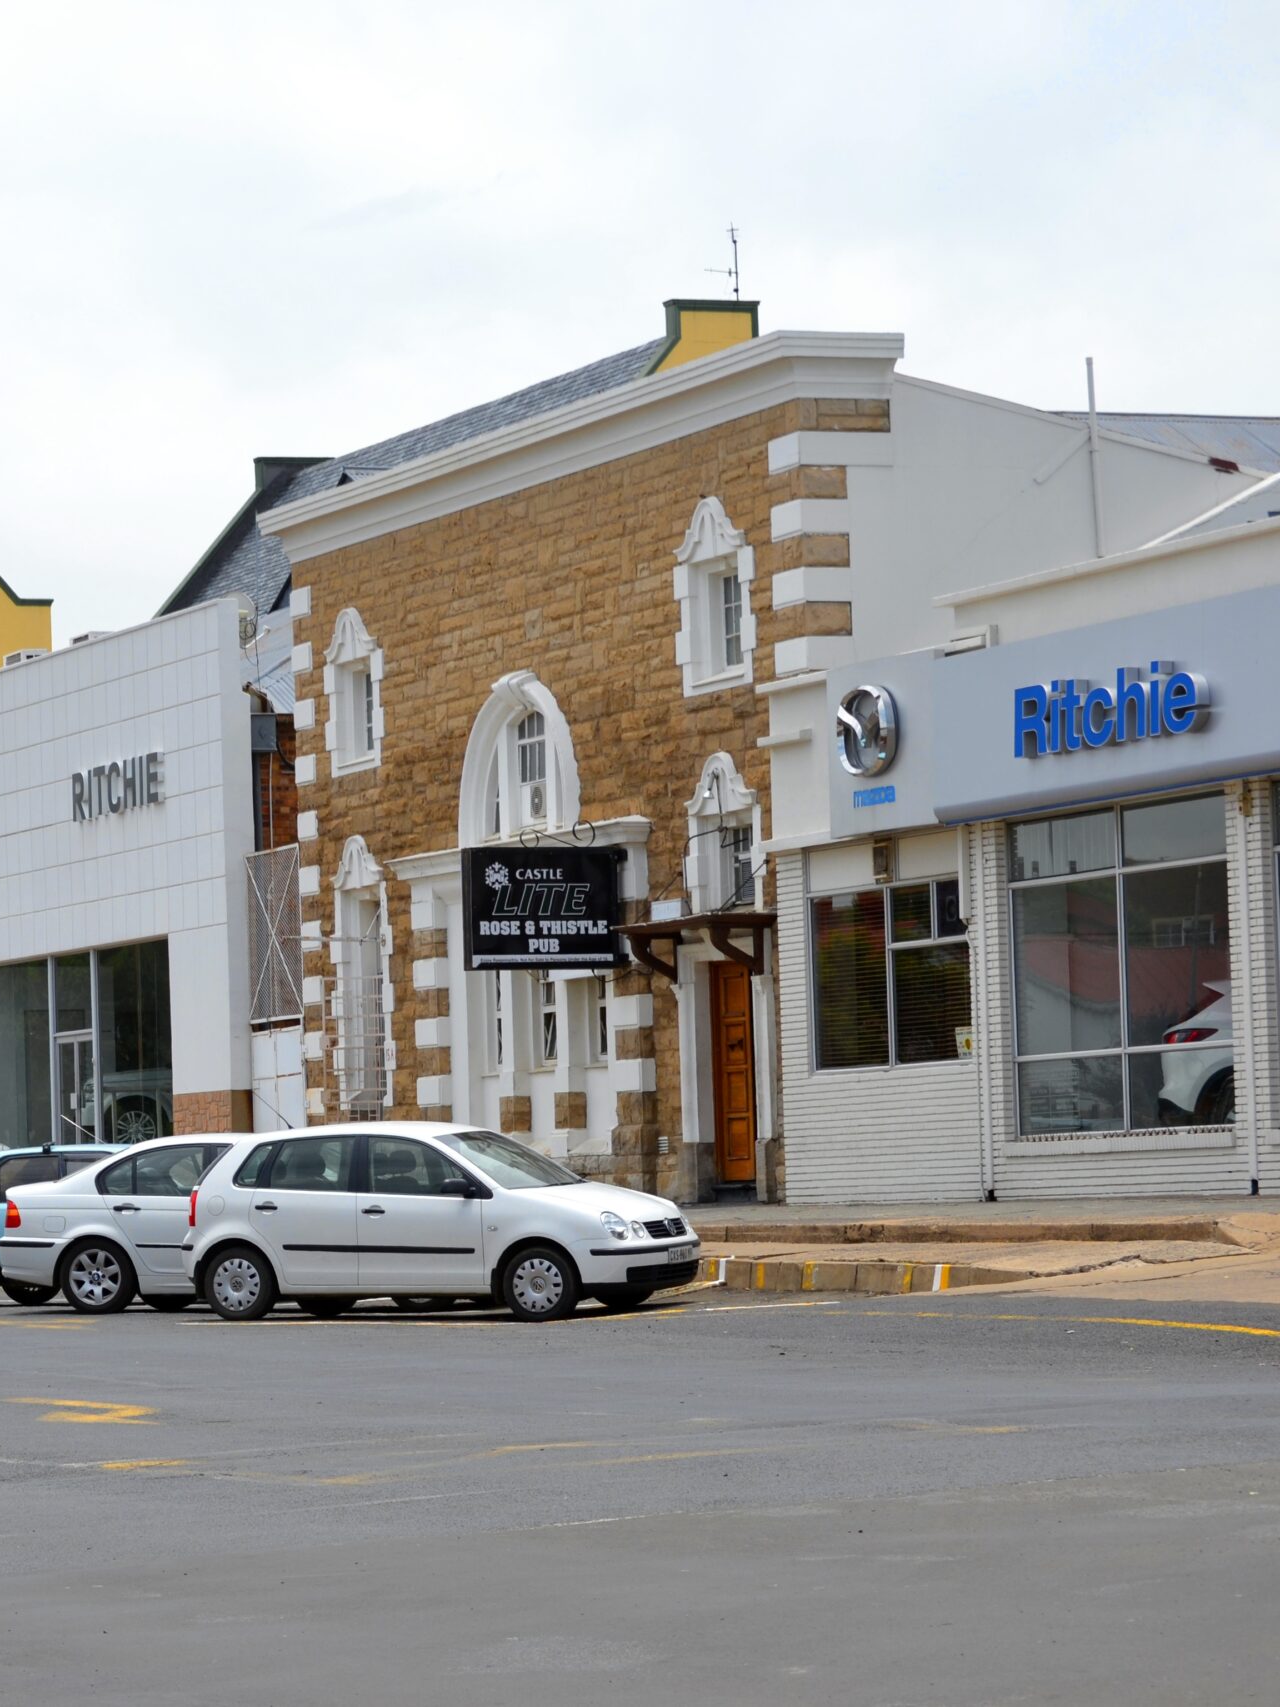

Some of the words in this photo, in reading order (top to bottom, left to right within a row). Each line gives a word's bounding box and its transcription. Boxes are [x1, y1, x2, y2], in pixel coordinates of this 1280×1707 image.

[1014, 661, 1197, 758] Ritchie
[72, 752, 160, 821] RITCHIE
[515, 868, 564, 880] CASTLE
[492, 883, 590, 916] LITE
[480, 921, 520, 936] ROSE
[525, 921, 535, 935] &
[539, 920, 608, 935] THISTLE
[528, 938, 560, 953] PUB
